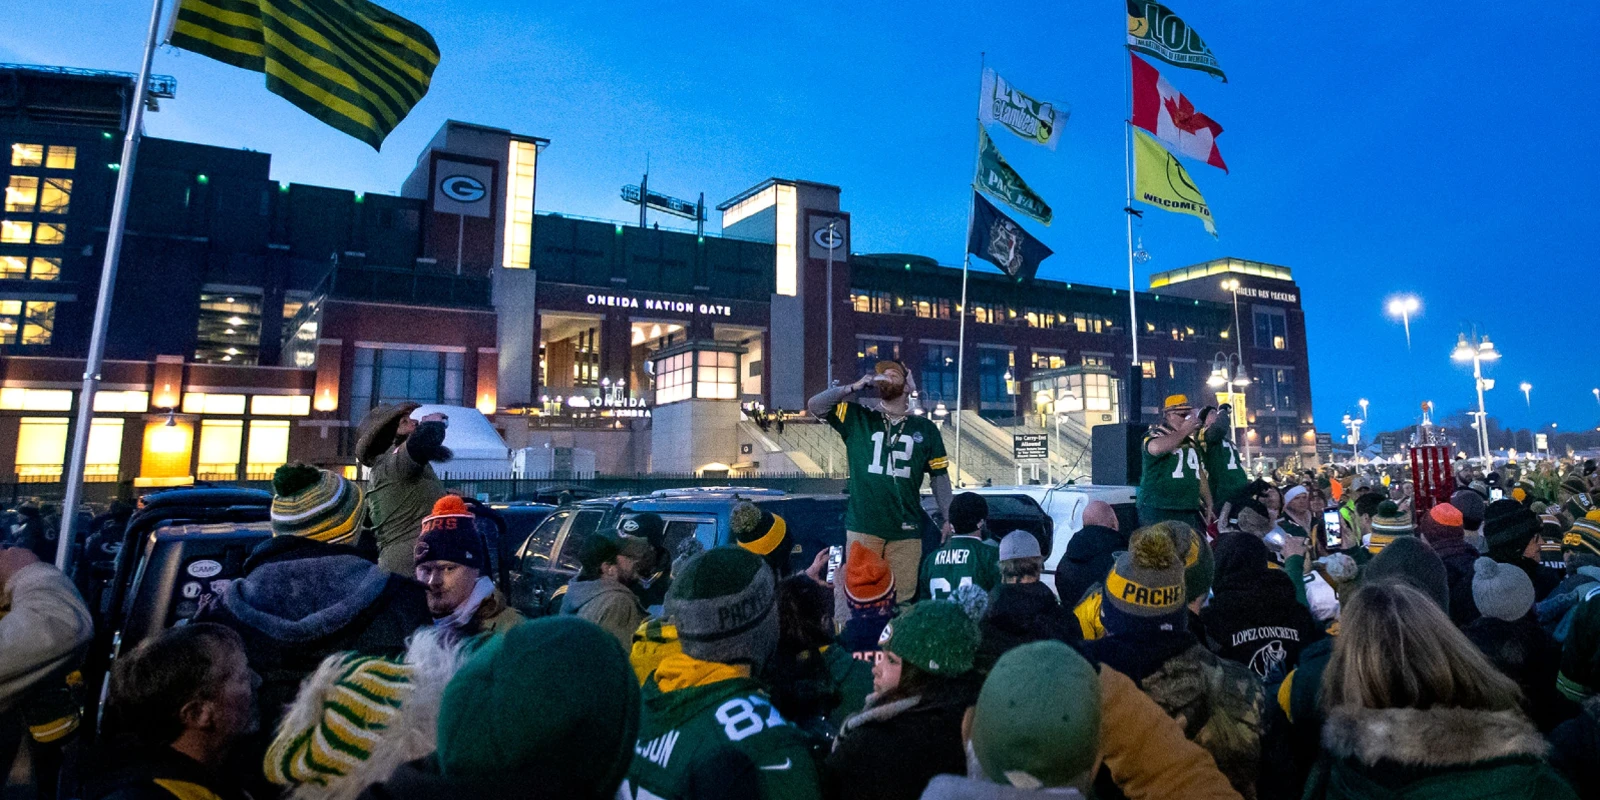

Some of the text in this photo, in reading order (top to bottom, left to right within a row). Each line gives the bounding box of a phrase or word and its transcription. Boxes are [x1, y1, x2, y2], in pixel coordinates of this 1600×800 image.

[1144, 192, 1210, 216] WELCOME TO
[587, 294, 731, 316] ONEIDA NATION GATE
[868, 431, 914, 479] 12
[1172, 447, 1209, 479] 74
[934, 548, 970, 566] KRAMER
[1232, 626, 1300, 647] LOPEZ CONCRETE
